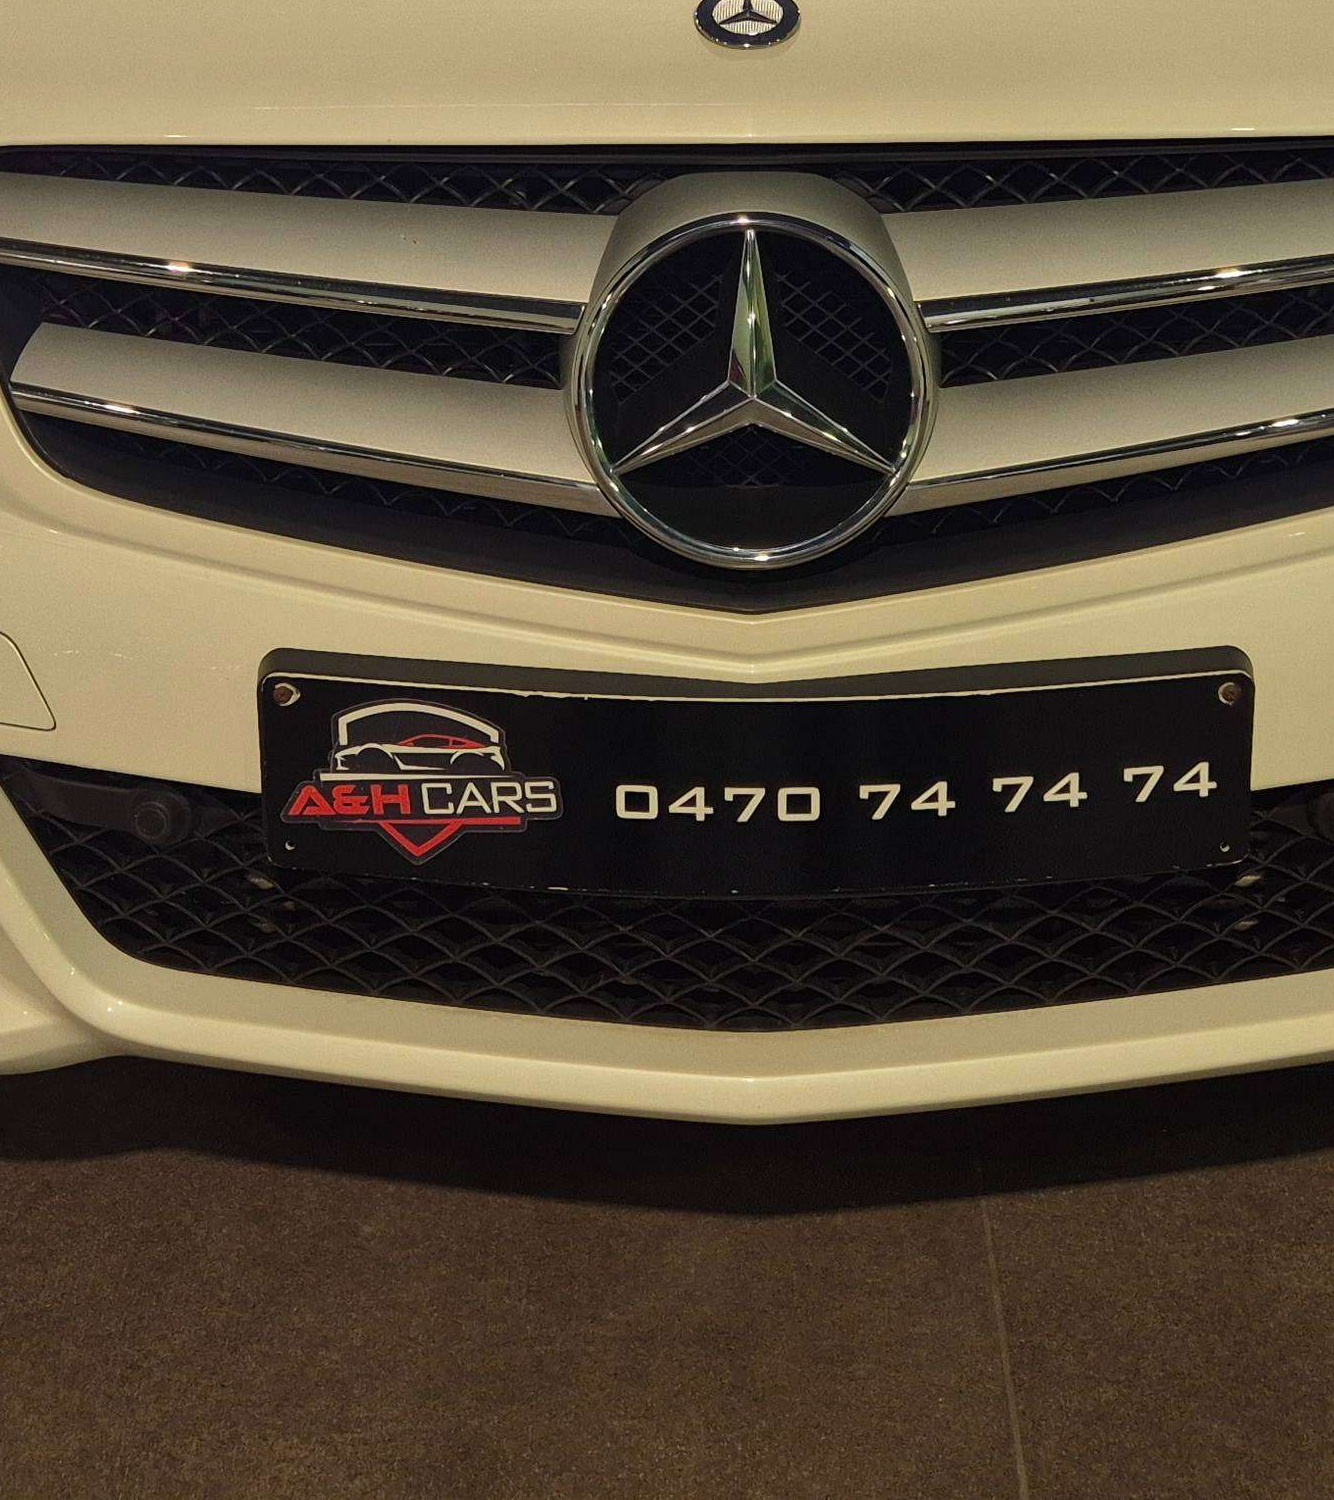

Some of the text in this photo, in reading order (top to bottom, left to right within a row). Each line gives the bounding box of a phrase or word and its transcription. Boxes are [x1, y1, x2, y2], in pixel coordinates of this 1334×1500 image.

[288, 781, 558, 816] A&H CARS
[615, 761, 1217, 822] 0470 74 74 74
